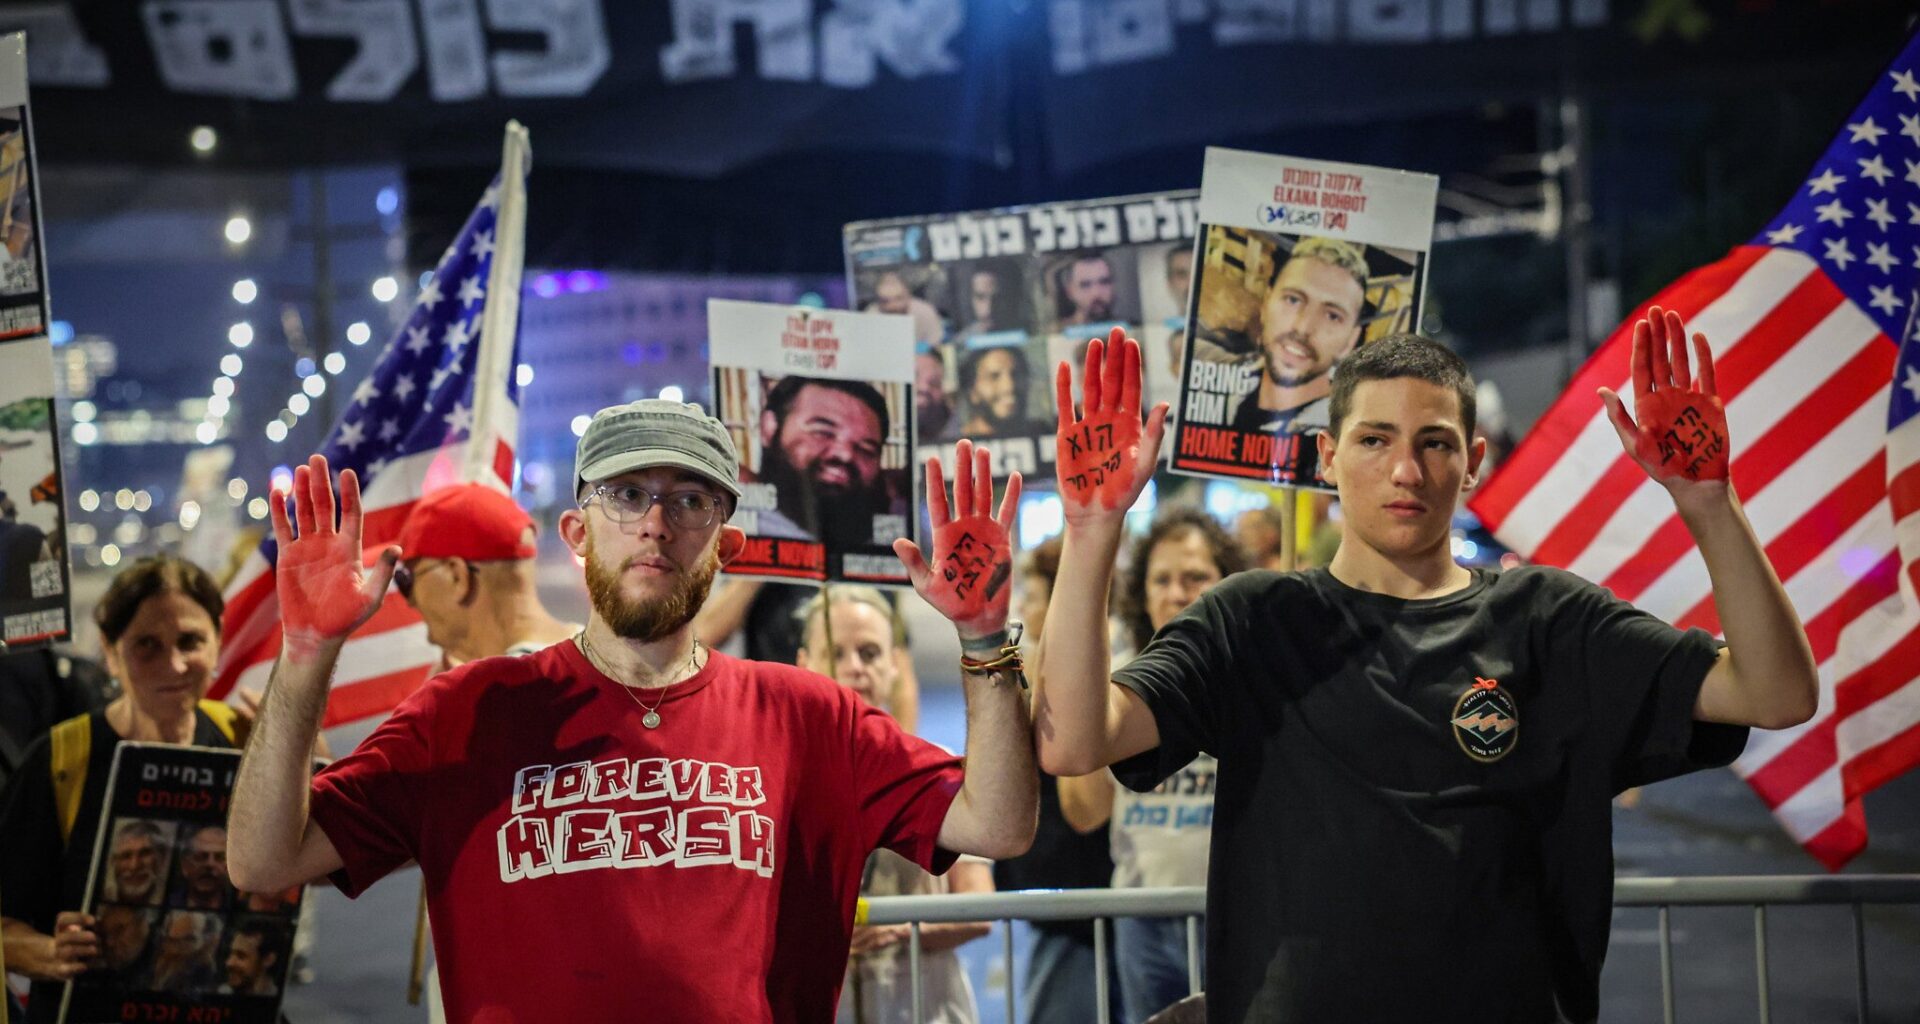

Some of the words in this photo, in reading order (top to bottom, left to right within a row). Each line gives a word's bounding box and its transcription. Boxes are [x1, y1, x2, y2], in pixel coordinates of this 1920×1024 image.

[1124, 197, 1201, 243] ולם
[1273, 186, 1318, 206] ELKANA
[1321, 192, 1367, 213] BOHBOT
[927, 211, 1025, 261] כולם
[1029, 205, 1122, 250] כולל
[1189, 360, 1251, 396] BRING
[1185, 391, 1226, 425] HIM
[1066, 423, 1113, 460] הוא
[1181, 426, 1238, 461] HOME
[1241, 433, 1300, 469] NOW!
[142, 763, 214, 786] בחיים
[512, 757, 767, 815] FOREVER
[497, 806, 775, 883] HERSH
